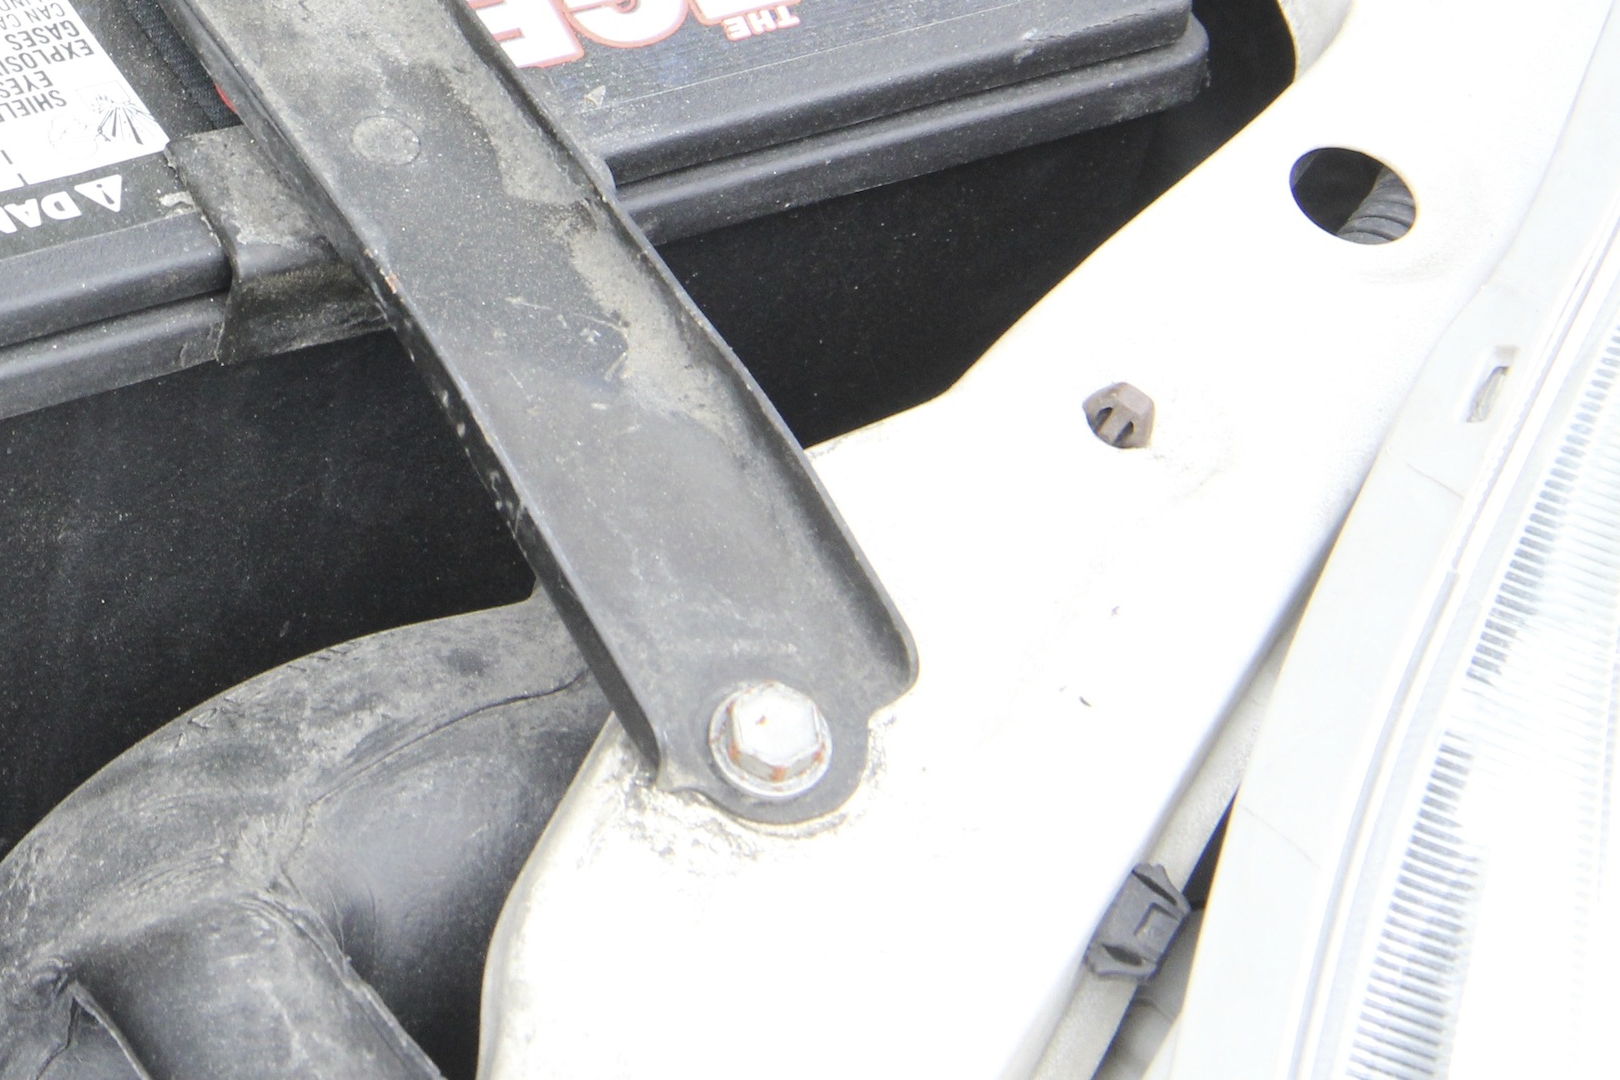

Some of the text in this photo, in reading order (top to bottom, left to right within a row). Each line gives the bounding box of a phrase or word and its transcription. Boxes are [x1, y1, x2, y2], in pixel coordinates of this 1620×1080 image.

[24, 3, 65, 23] CAN
[723, 3, 803, 42] THE
[4, 20, 80, 51] GASES
